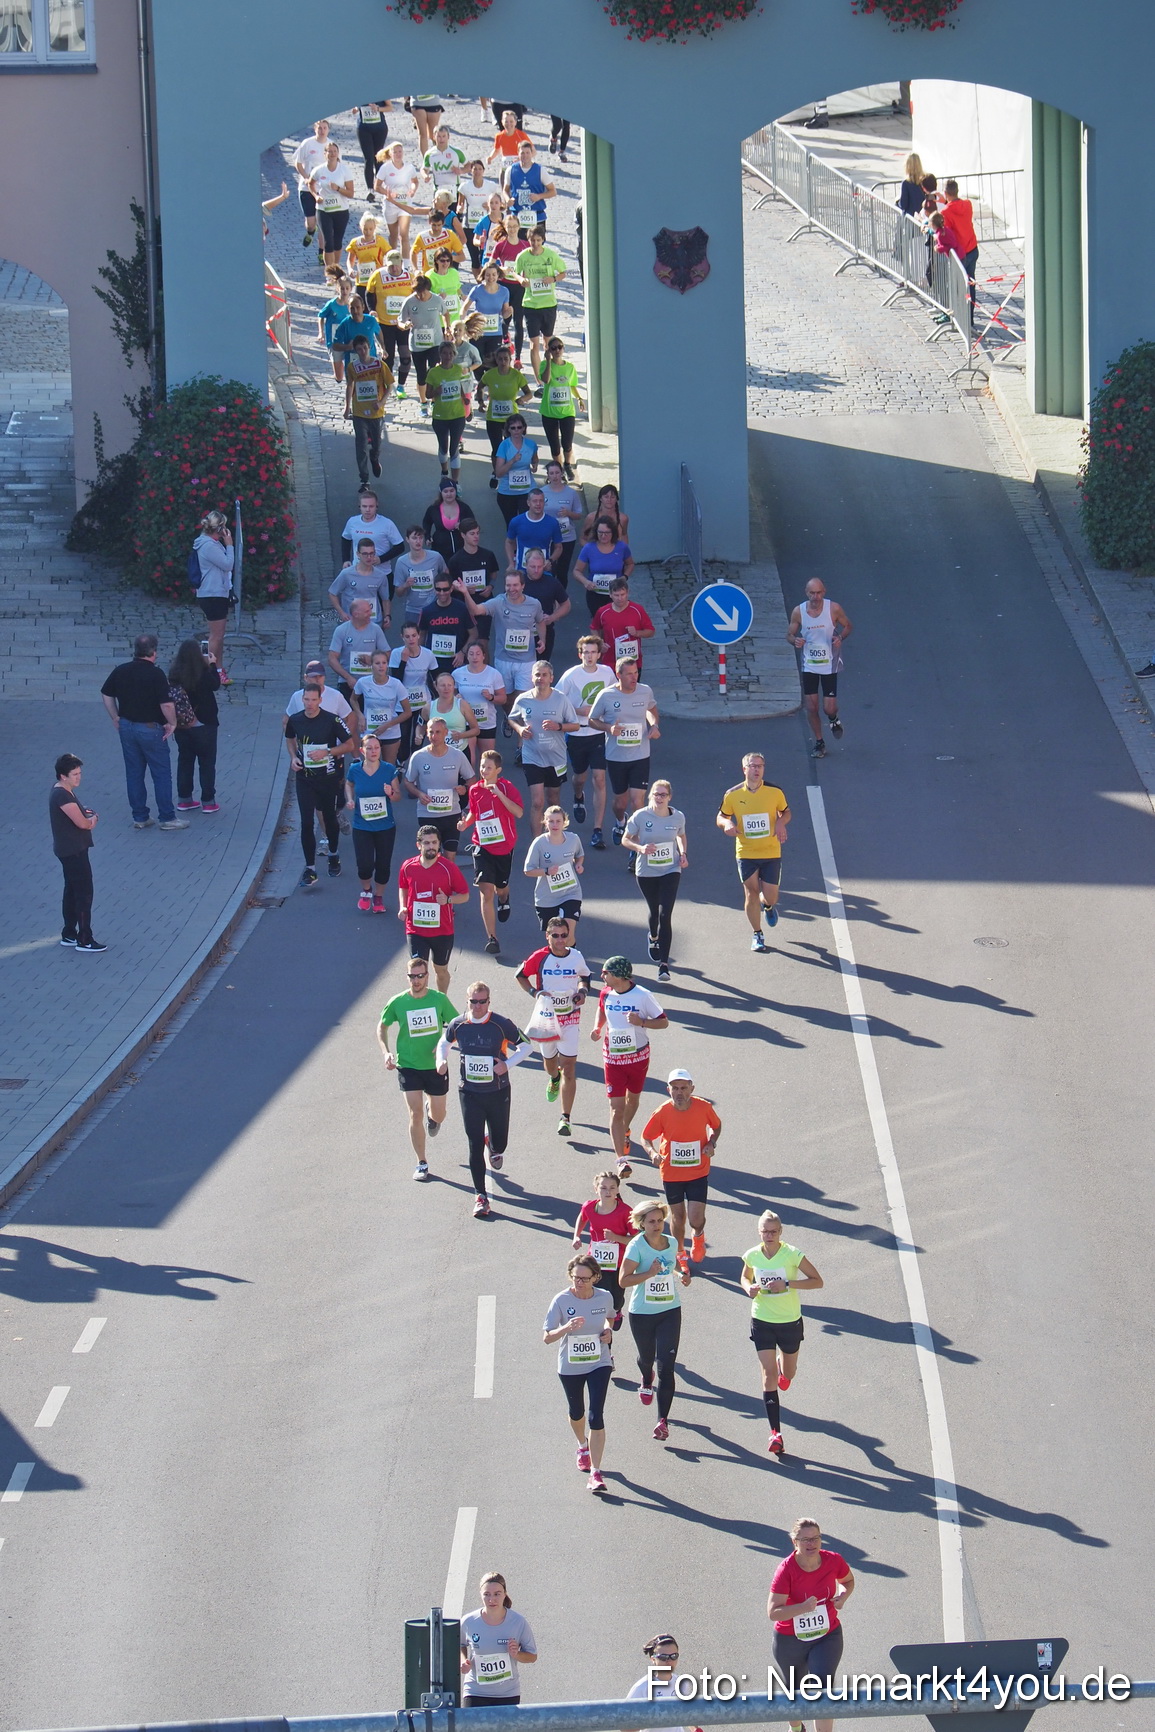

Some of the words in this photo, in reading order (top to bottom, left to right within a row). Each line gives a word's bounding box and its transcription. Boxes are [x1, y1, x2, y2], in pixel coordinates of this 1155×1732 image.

[359, 386, 374, 394] 5095
[444, 386, 458, 394] 5153
[414, 576, 430, 584] 5195
[466, 576, 482, 584] 5184
[430, 616, 459, 626] adidas
[509, 635, 526, 644] 5157
[435, 641, 452, 649] 5159
[619, 647, 636, 656] 5125
[620, 730, 639, 740] 5165
[432, 796, 450, 804] 5022
[364, 802, 382, 812] 5024
[746, 820, 766, 829] 5016
[482, 826, 498, 834] 5111
[551, 870, 570, 882] 5013
[416, 908, 436, 918] 5118
[412, 1016, 432, 1026] 5211
[612, 1036, 632, 1044] 5066
[469, 1063, 488, 1072] 5025
[675, 1148, 695, 1158] 5081
[594, 1250, 614, 1261] 5120
[650, 1282, 670, 1292] 5021
[574, 1342, 596, 1352] 5060
[800, 1614, 824, 1628] 5119
[480, 1660, 506, 1672] 5010
